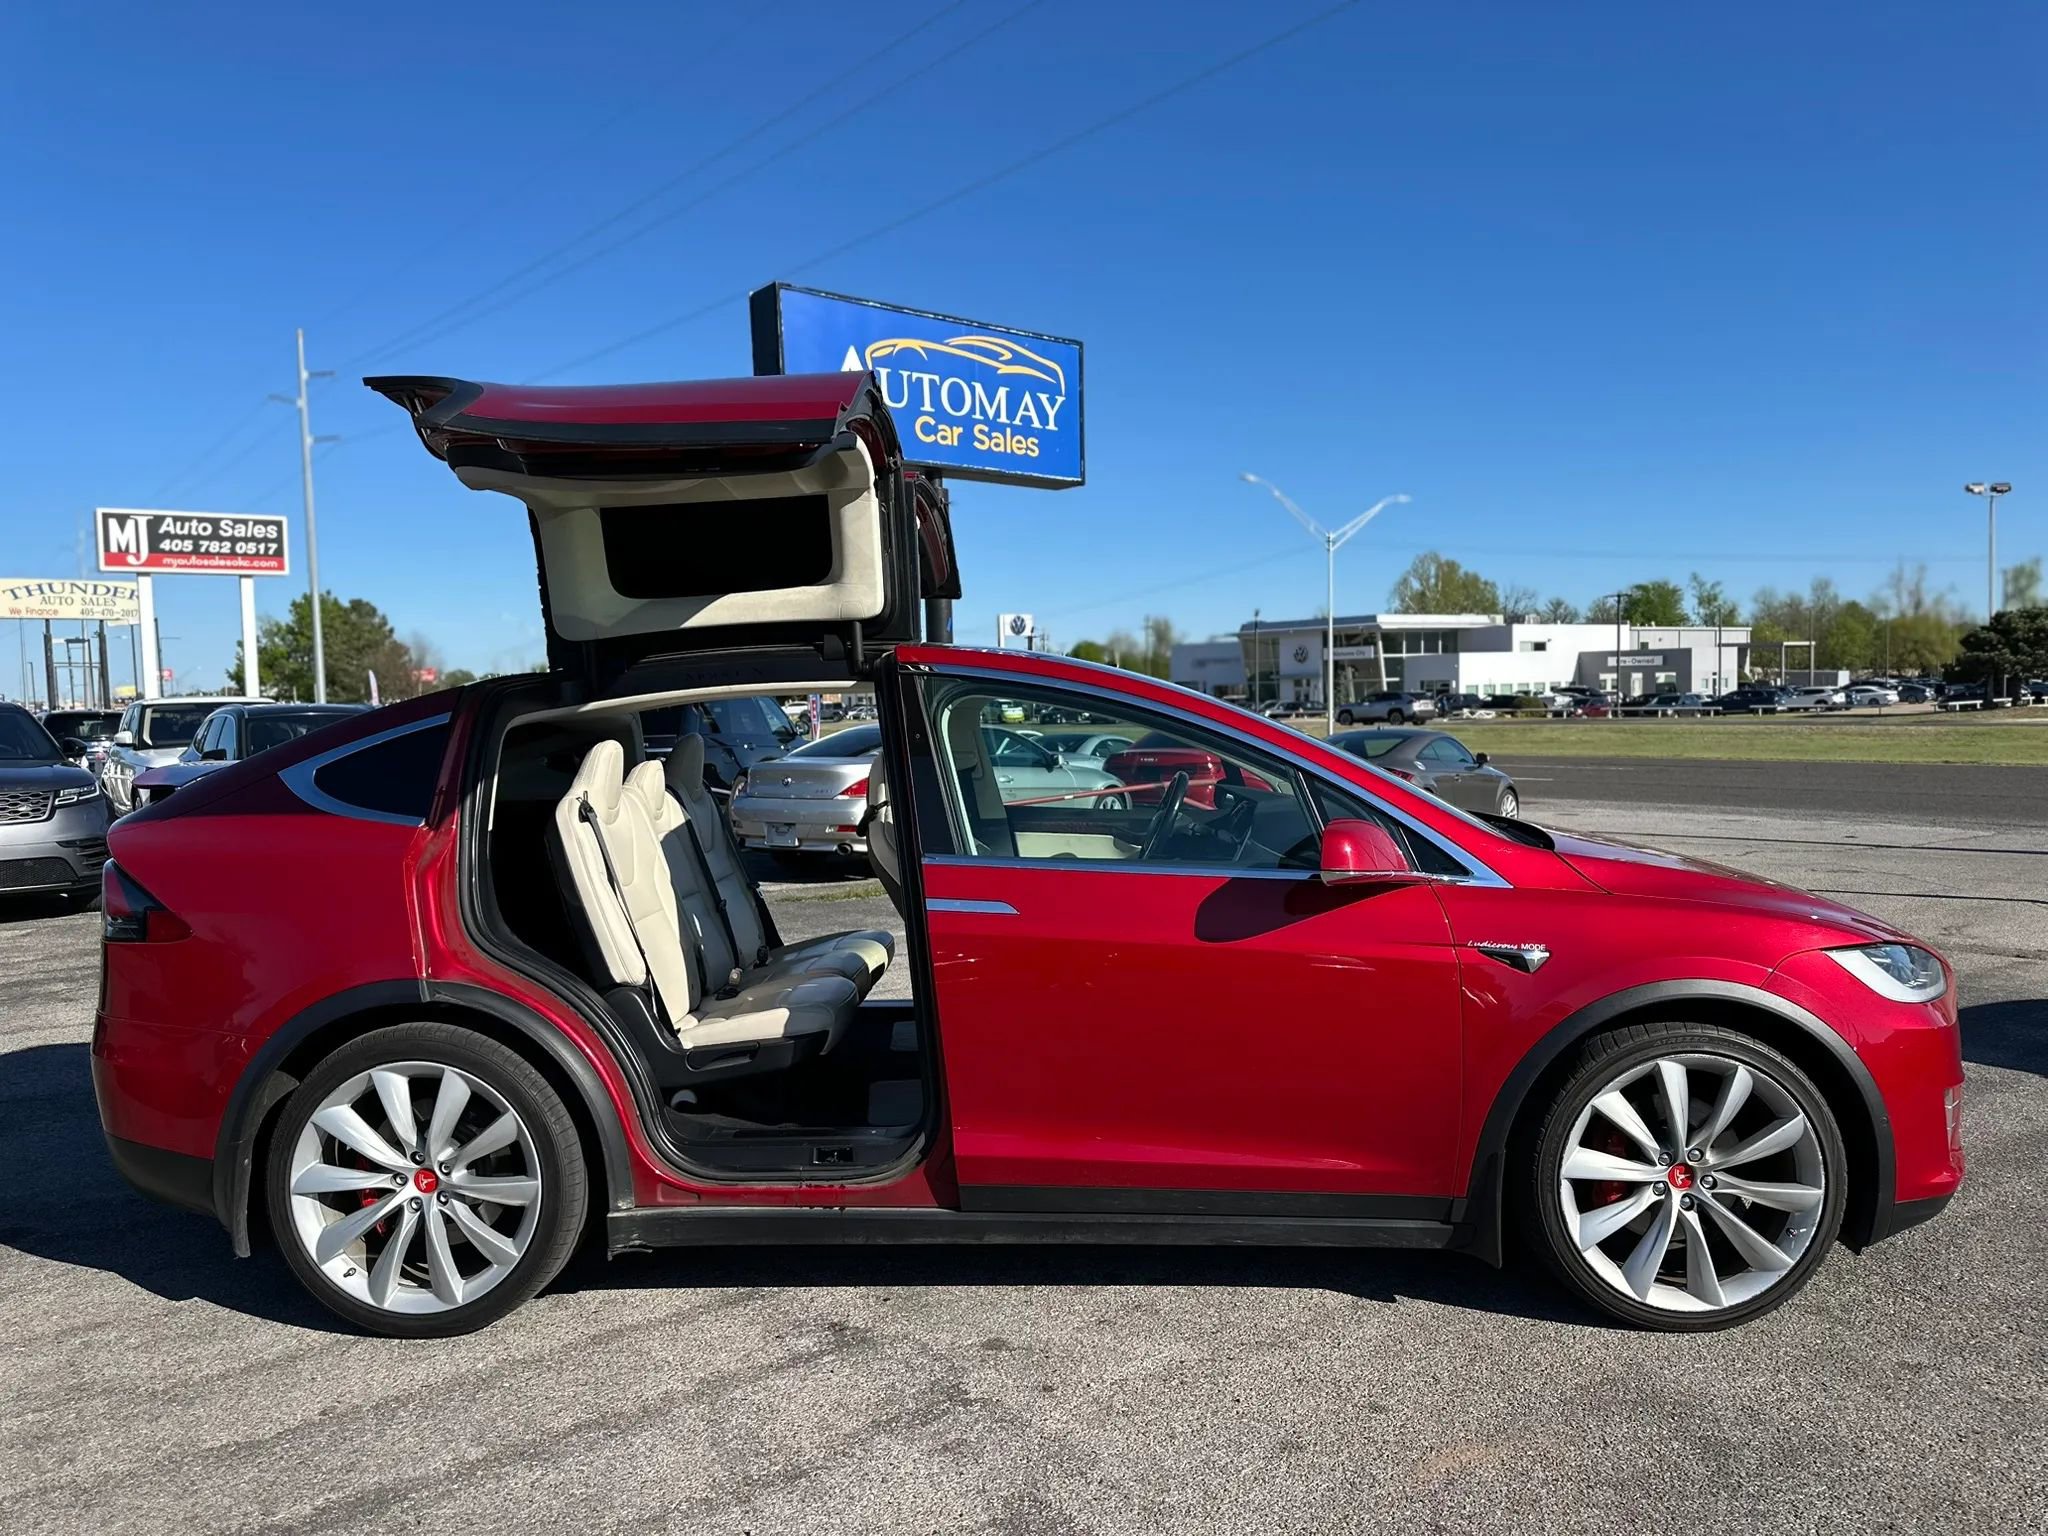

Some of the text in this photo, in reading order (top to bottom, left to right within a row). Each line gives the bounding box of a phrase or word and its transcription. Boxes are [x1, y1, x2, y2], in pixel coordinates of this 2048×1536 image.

[915, 415, 1040, 457] Car Sales
[158, 516, 278, 539] Auto Sales
[107, 515, 154, 566] MJ
[159, 539, 278, 555] 405 782 0517
[162, 555, 278, 568] mjautosalesokc.com
[40, 596, 117, 607] AUTO SALES
[9, 607, 59, 616] We Finance
[80, 608, 138, 618] 405-470-2017
[1521, 943, 1546, 951] MODE
